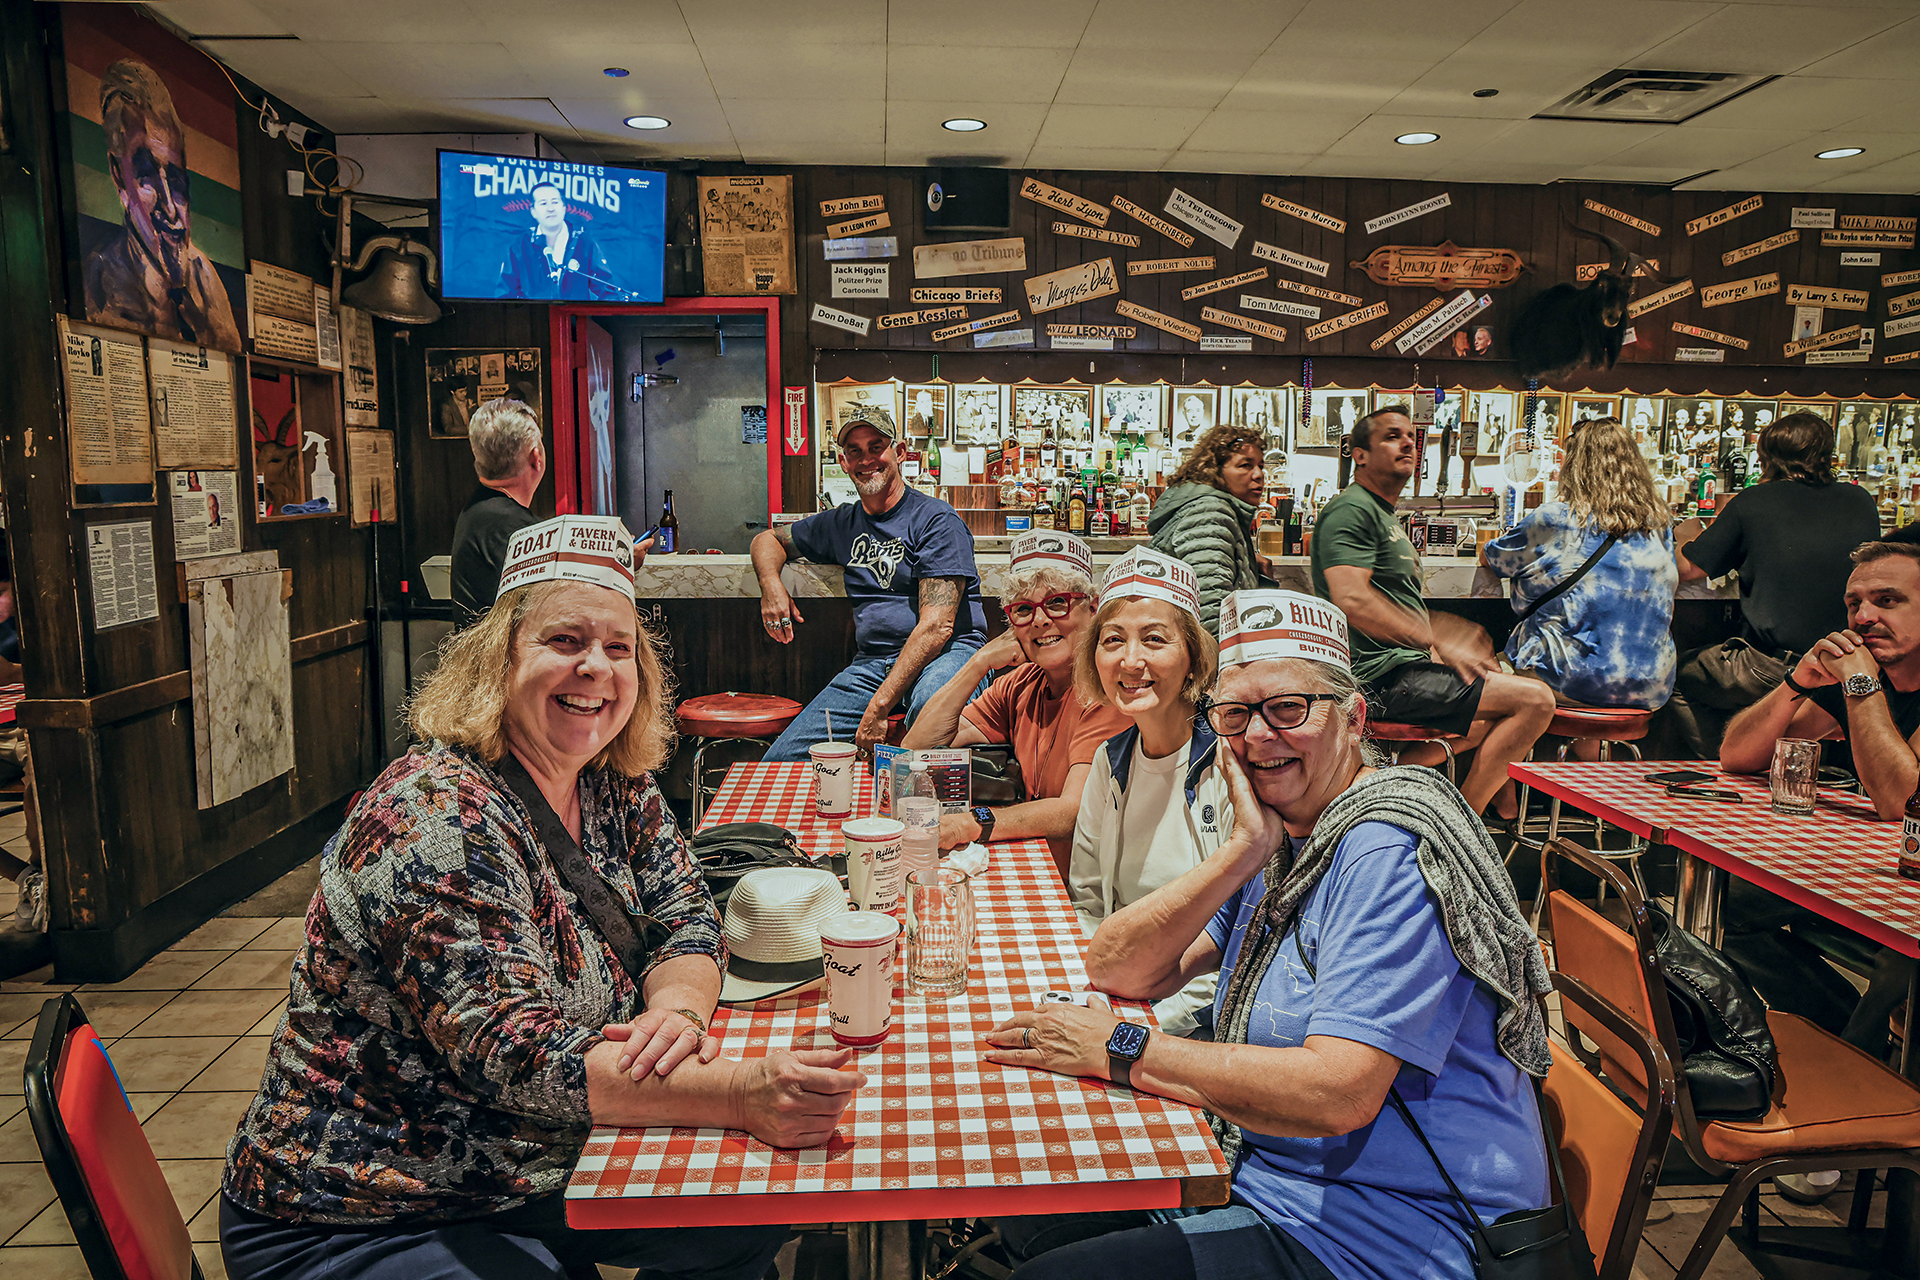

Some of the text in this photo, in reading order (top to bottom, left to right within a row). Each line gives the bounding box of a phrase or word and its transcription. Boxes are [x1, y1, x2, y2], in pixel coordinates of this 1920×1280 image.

[496, 157, 604, 176] WORLD SERIES
[474, 163, 620, 213] CHAMPIONS
[824, 198, 880, 213] By John Bell
[1026, 183, 1105, 221] By Herb Lyon
[1115, 197, 1191, 246] DICK HACKENBERG
[1171, 203, 1216, 232] Chicago Tribune
[1176, 194, 1237, 233] BY TED GREGORY
[1265, 196, 1341, 230] By George Murray
[1369, 196, 1447, 231] By JOHN FLYNN ROONEY
[1585, 201, 1597, 209] BY
[1600, 206, 1634, 225] CHARLIE
[1689, 199, 1760, 232] By Tom Watts
[840, 218, 878, 234] BY LEON PITT
[1843, 218, 1914, 230] MIKE ROYKO
[1053, 223, 1138, 245] BY JEFF LYON
[1841, 233, 1858, 242] Royko
[971, 244, 1023, 261] Tribune
[1256, 246, 1325, 273] By R. Bruce Dold
[834, 266, 886, 276] Jack Higgins
[1130, 264, 1142, 273] BY
[1146, 262, 1180, 271] ROBERT
[1390, 258, 1438, 277] Among
[1439, 260, 1459, 274] the
[1184, 270, 1265, 298] By Jon and Abra Anderson
[1286, 282, 1301, 291] LINE
[1314, 288, 1330, 298] TYPE
[1332, 293, 1342, 301] OR
[1704, 279, 1778, 303] George Vass
[914, 290, 999, 301] Chicago Briefs
[1030, 295, 1041, 304] By
[1792, 290, 1865, 306] By Larry S. Finley
[1246, 298, 1316, 318] Tom McNamee
[1640, 299, 1661, 313] Robert
[818, 309, 865, 329] Don DeBat
[881, 308, 963, 328] Gene Kessler
[935, 326, 967, 339] Sports
[970, 313, 1018, 330] Illustrated
[1120, 305, 1200, 338] by Robert Wiedrich
[1203, 310, 1216, 320] BY
[1219, 313, 1243, 327] JOHN
[1309, 304, 1387, 338] JACK R. GRIFFIN
[1391, 297, 1443, 336] DAVID CONDON
[1401, 296, 1468, 349] By Abdon M. Pallasch
[67, 335, 85, 346] Mike
[1048, 326, 1134, 338] WILL LEONARD
[1688, 326, 1719, 341] ARTHUR
[68, 346, 90, 358] Royko
[1786, 336, 1827, 353] By William
[788, 393, 803, 402] FIRE
[512, 528, 558, 559] GOAT
[571, 527, 616, 541] TAVERN
[569, 538, 613, 552] & GRILL
[1018, 536, 1037, 548] TAVERN
[1068, 540, 1090, 563] BILLY
[502, 574, 518, 587] ANY
[521, 566, 546, 578] TIME
[1172, 594, 1192, 607] BUTT
[1221, 606, 1237, 624] TAVERN
[1289, 601, 1333, 632] BILLY
[1299, 644, 1337, 659] BUTT IN
[877, 751, 894, 760] FIZZY
[816, 762, 841, 776] Goat
[876, 846, 896, 860] Billy
[824, 953, 862, 977] Goat
[830, 1012, 850, 1025] Grill
